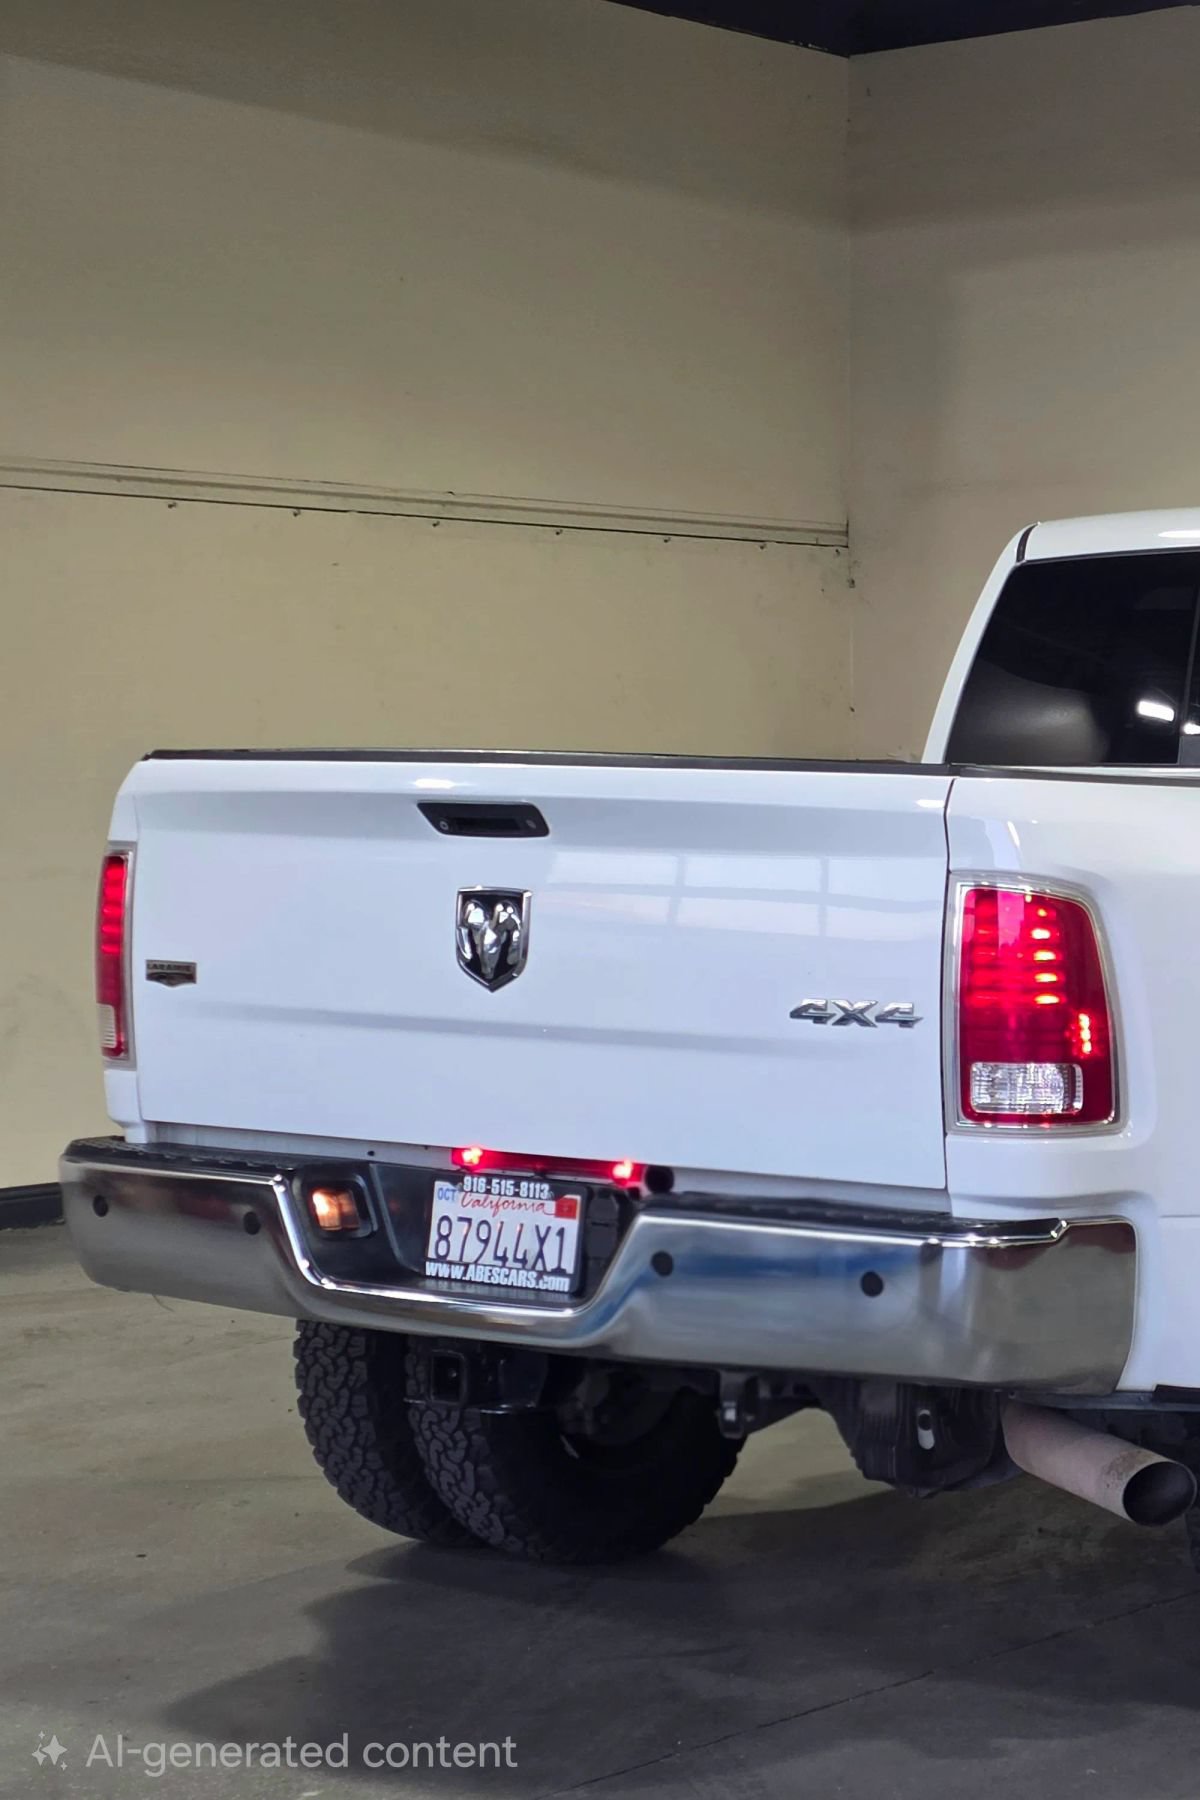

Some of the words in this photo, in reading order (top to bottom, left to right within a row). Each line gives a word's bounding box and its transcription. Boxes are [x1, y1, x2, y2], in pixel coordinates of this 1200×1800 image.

[437, 1187, 457, 1201] OCT
[463, 1176, 550, 1199] 916-515-8113
[461, 1192, 555, 1217] California
[435, 1215, 567, 1275] 87944X1
